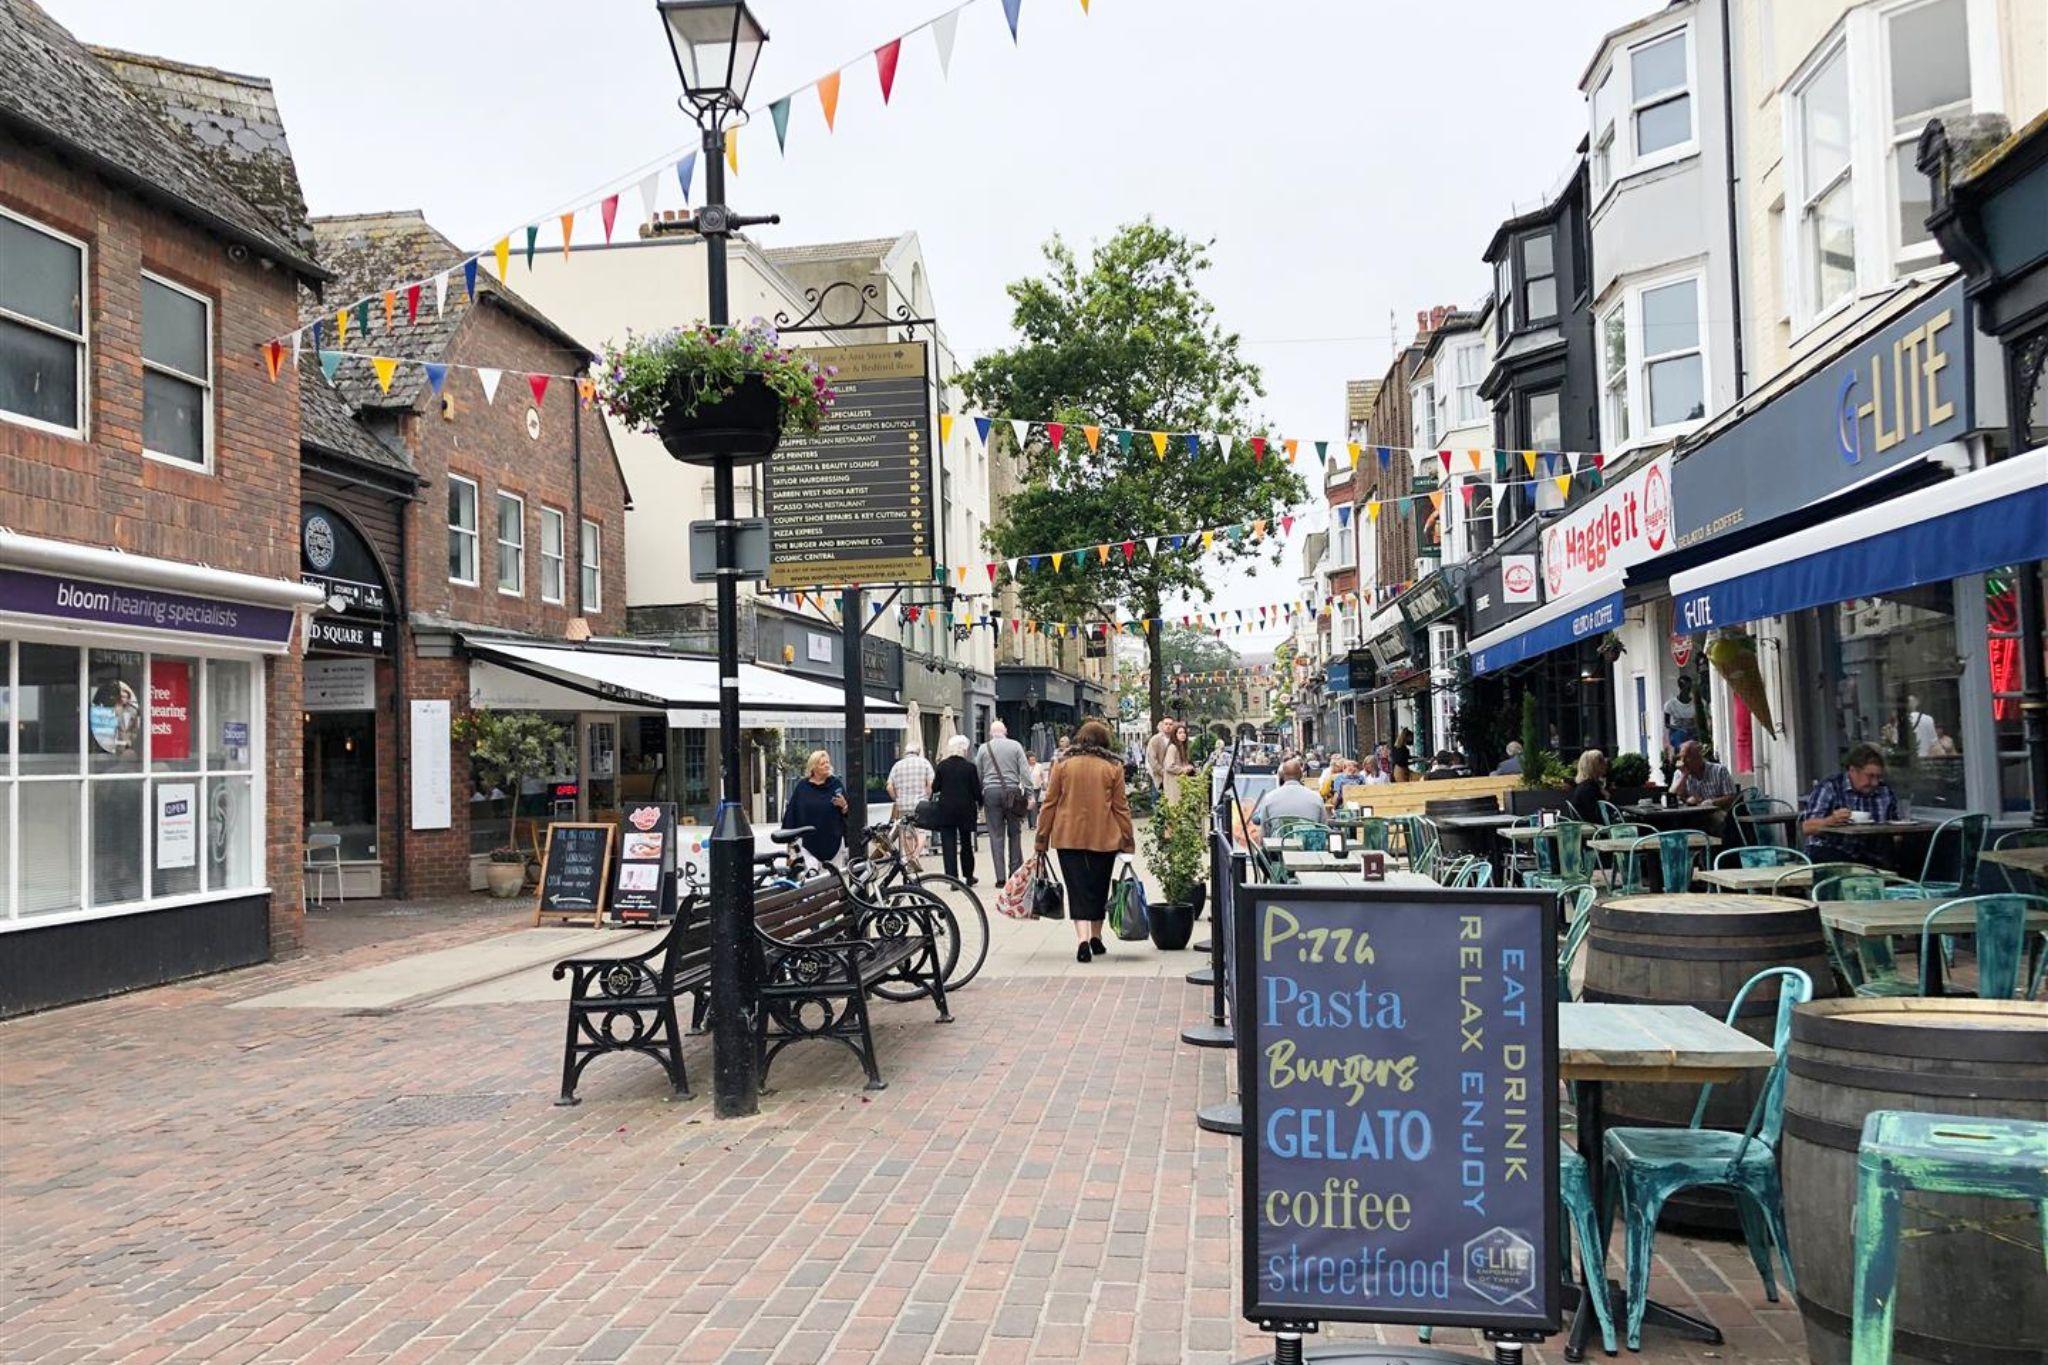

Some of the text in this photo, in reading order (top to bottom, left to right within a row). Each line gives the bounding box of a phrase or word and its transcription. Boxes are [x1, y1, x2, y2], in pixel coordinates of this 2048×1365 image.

[827, 385, 857, 393] WELLERS
[1837, 309, 1955, 464] G-LITE
[881, 421, 916, 429] BOUTIQUE
[808, 436, 834, 445] ITALIAN
[834, 435, 877, 444] RESTAURANT
[772, 451, 818, 460] GPS PRINTERS
[772, 465, 785, 473] THE
[787, 463, 813, 471] HEALTH
[821, 462, 848, 470] BEAUTY
[850, 460, 880, 469] LOUNGE
[799, 475, 850, 484] HAIRDRESSING
[802, 489, 821, 497] WEST
[822, 488, 844, 496] NEON
[845, 487, 869, 495] ARTIST
[773, 503, 803, 511] PICASSO
[824, 500, 866, 508] RESTAURANT
[773, 516, 803, 524] COUNTY
[804, 515, 824, 523] SHOE
[825, 513, 853, 521] REPAIRS
[1713, 508, 1744, 532] COFFEE
[774, 527, 823, 537] PIZZA EXPRESS
[1565, 492, 1638, 572] Haggle it
[789, 540, 817, 549] BURGER
[818, 539, 835, 547] AND
[836, 538, 870, 547] BROWNIE
[774, 552, 835, 562] COSMIC CENTRAL
[57, 583, 238, 627] bloom hearing specialists
[1684, 595, 1713, 629] G-LITE
[323, 625, 364, 644] SQUARE
[166, 803, 186, 814] OPEN
[1262, 904, 1375, 964] Pizza
[1262, 976, 1406, 1029] Pasta
[1264, 1038, 1418, 1107] Burgers
[1459, 916, 1486, 1216] RELAX ENJOY
[1501, 949, 1528, 1183] EAT DRINK
[1266, 1107, 1431, 1162] GELATO
[1265, 1177, 1412, 1232] coffee
[1471, 1247, 1529, 1270] G-LITE
[1268, 1243, 1449, 1300] streetfood
